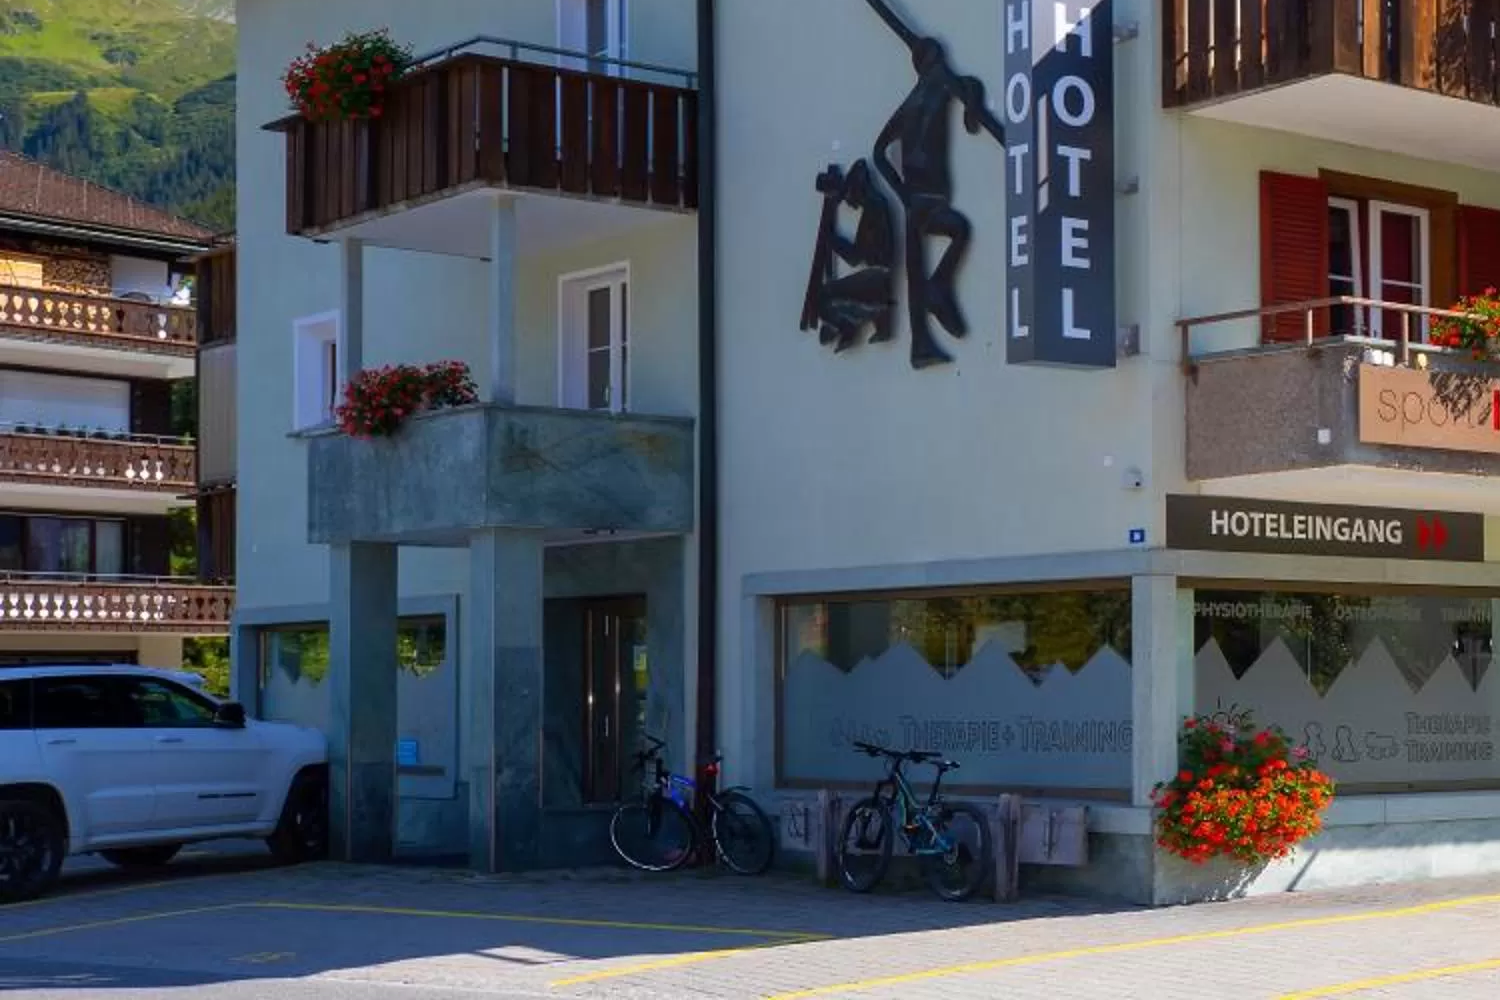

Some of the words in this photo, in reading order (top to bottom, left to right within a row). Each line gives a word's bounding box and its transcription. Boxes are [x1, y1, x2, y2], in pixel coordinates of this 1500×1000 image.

[1007, 0, 1031, 338] HOTEL
[1053, 2, 1095, 340] HOTEL
[1210, 509, 1403, 544] HOTELEINGANG
